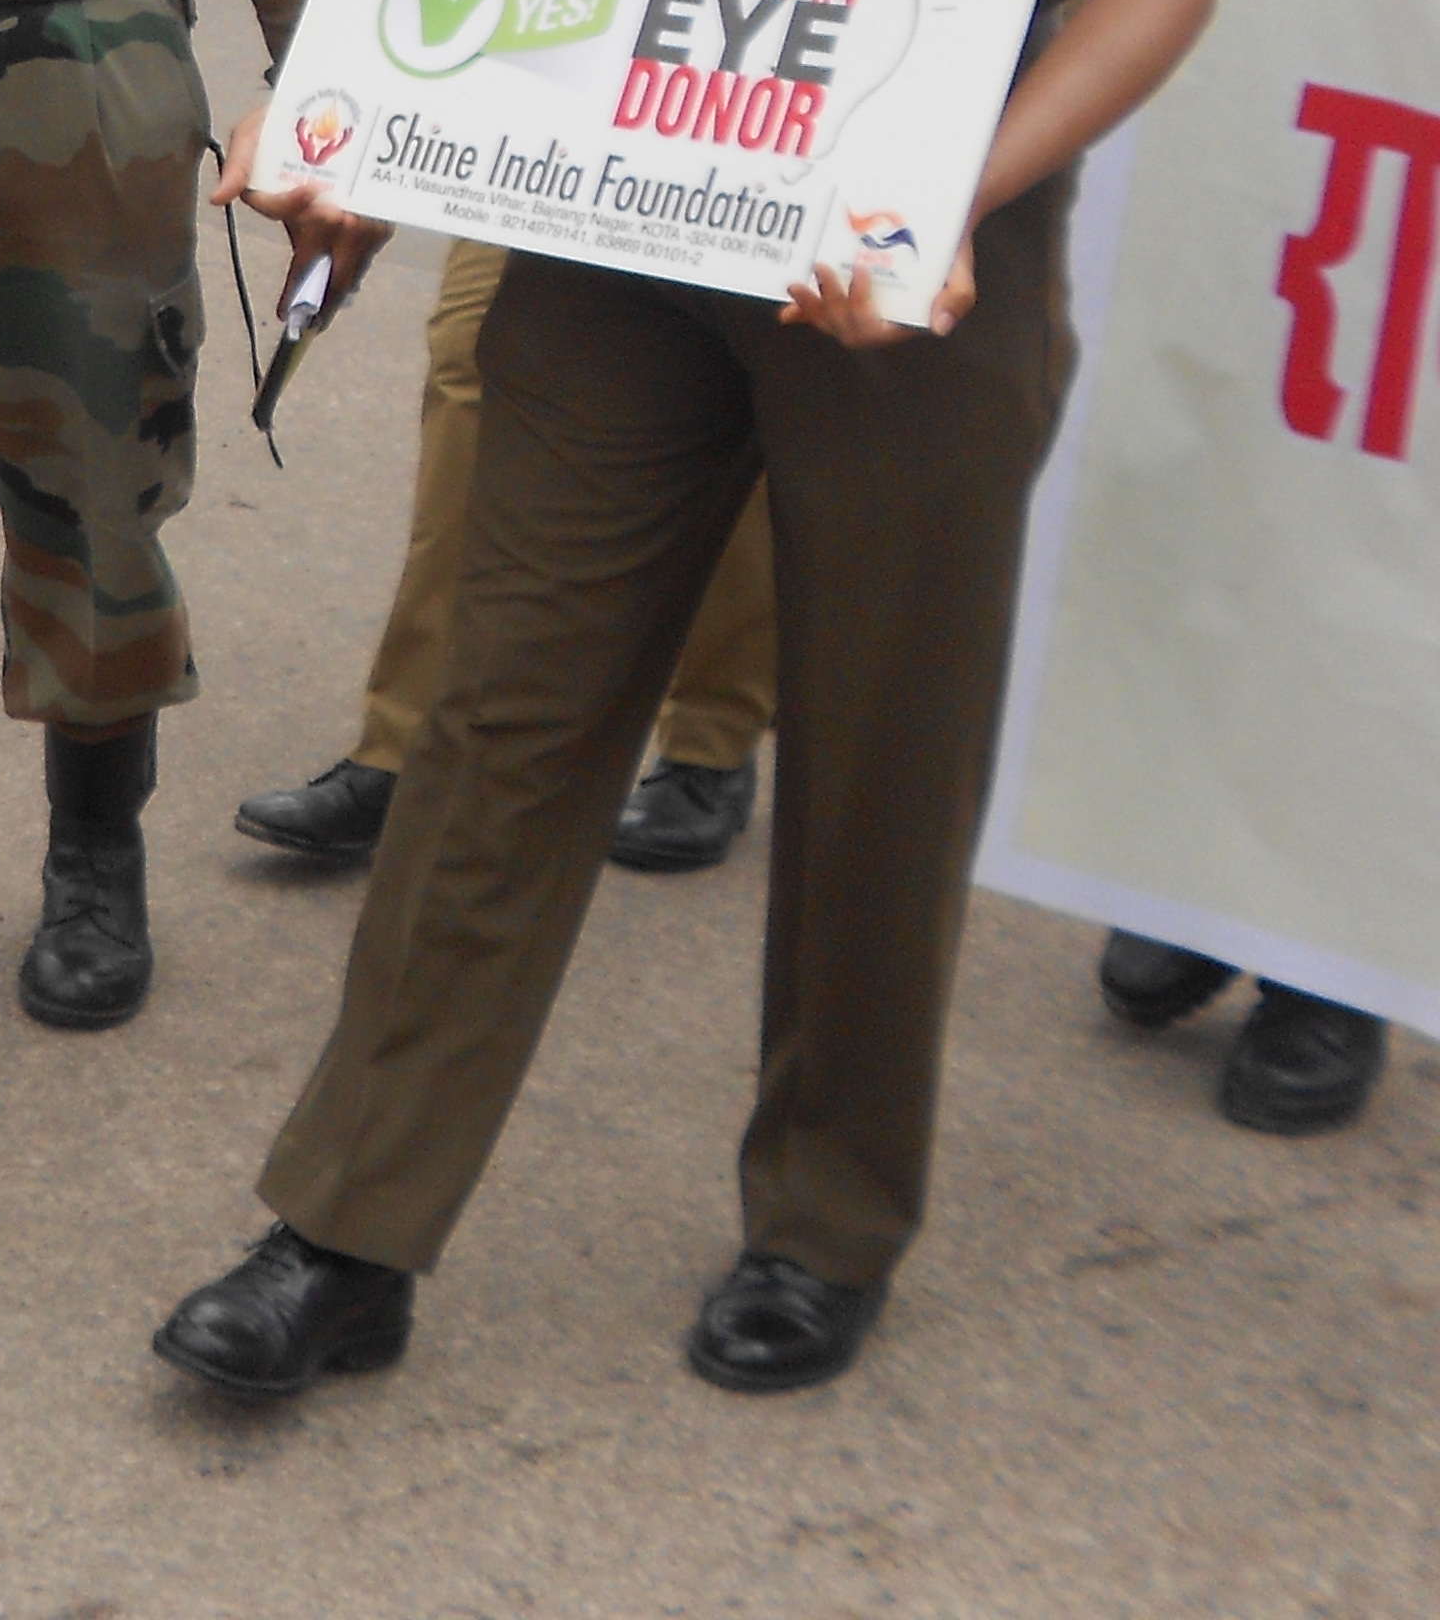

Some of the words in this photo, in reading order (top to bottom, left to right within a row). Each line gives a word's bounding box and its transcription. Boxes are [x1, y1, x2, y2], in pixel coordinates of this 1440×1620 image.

[612, 57, 828, 159] DONOR
[377, 113, 478, 180] Shine
[488, 135, 584, 201] India
[593, 155, 806, 242] Foundation
[414, 176, 486, 203] Vasundhra
[532, 200, 586, 226] Bajrang
[642, 223, 681, 241] KOTA
[443, 201, 490, 223] Mobile
